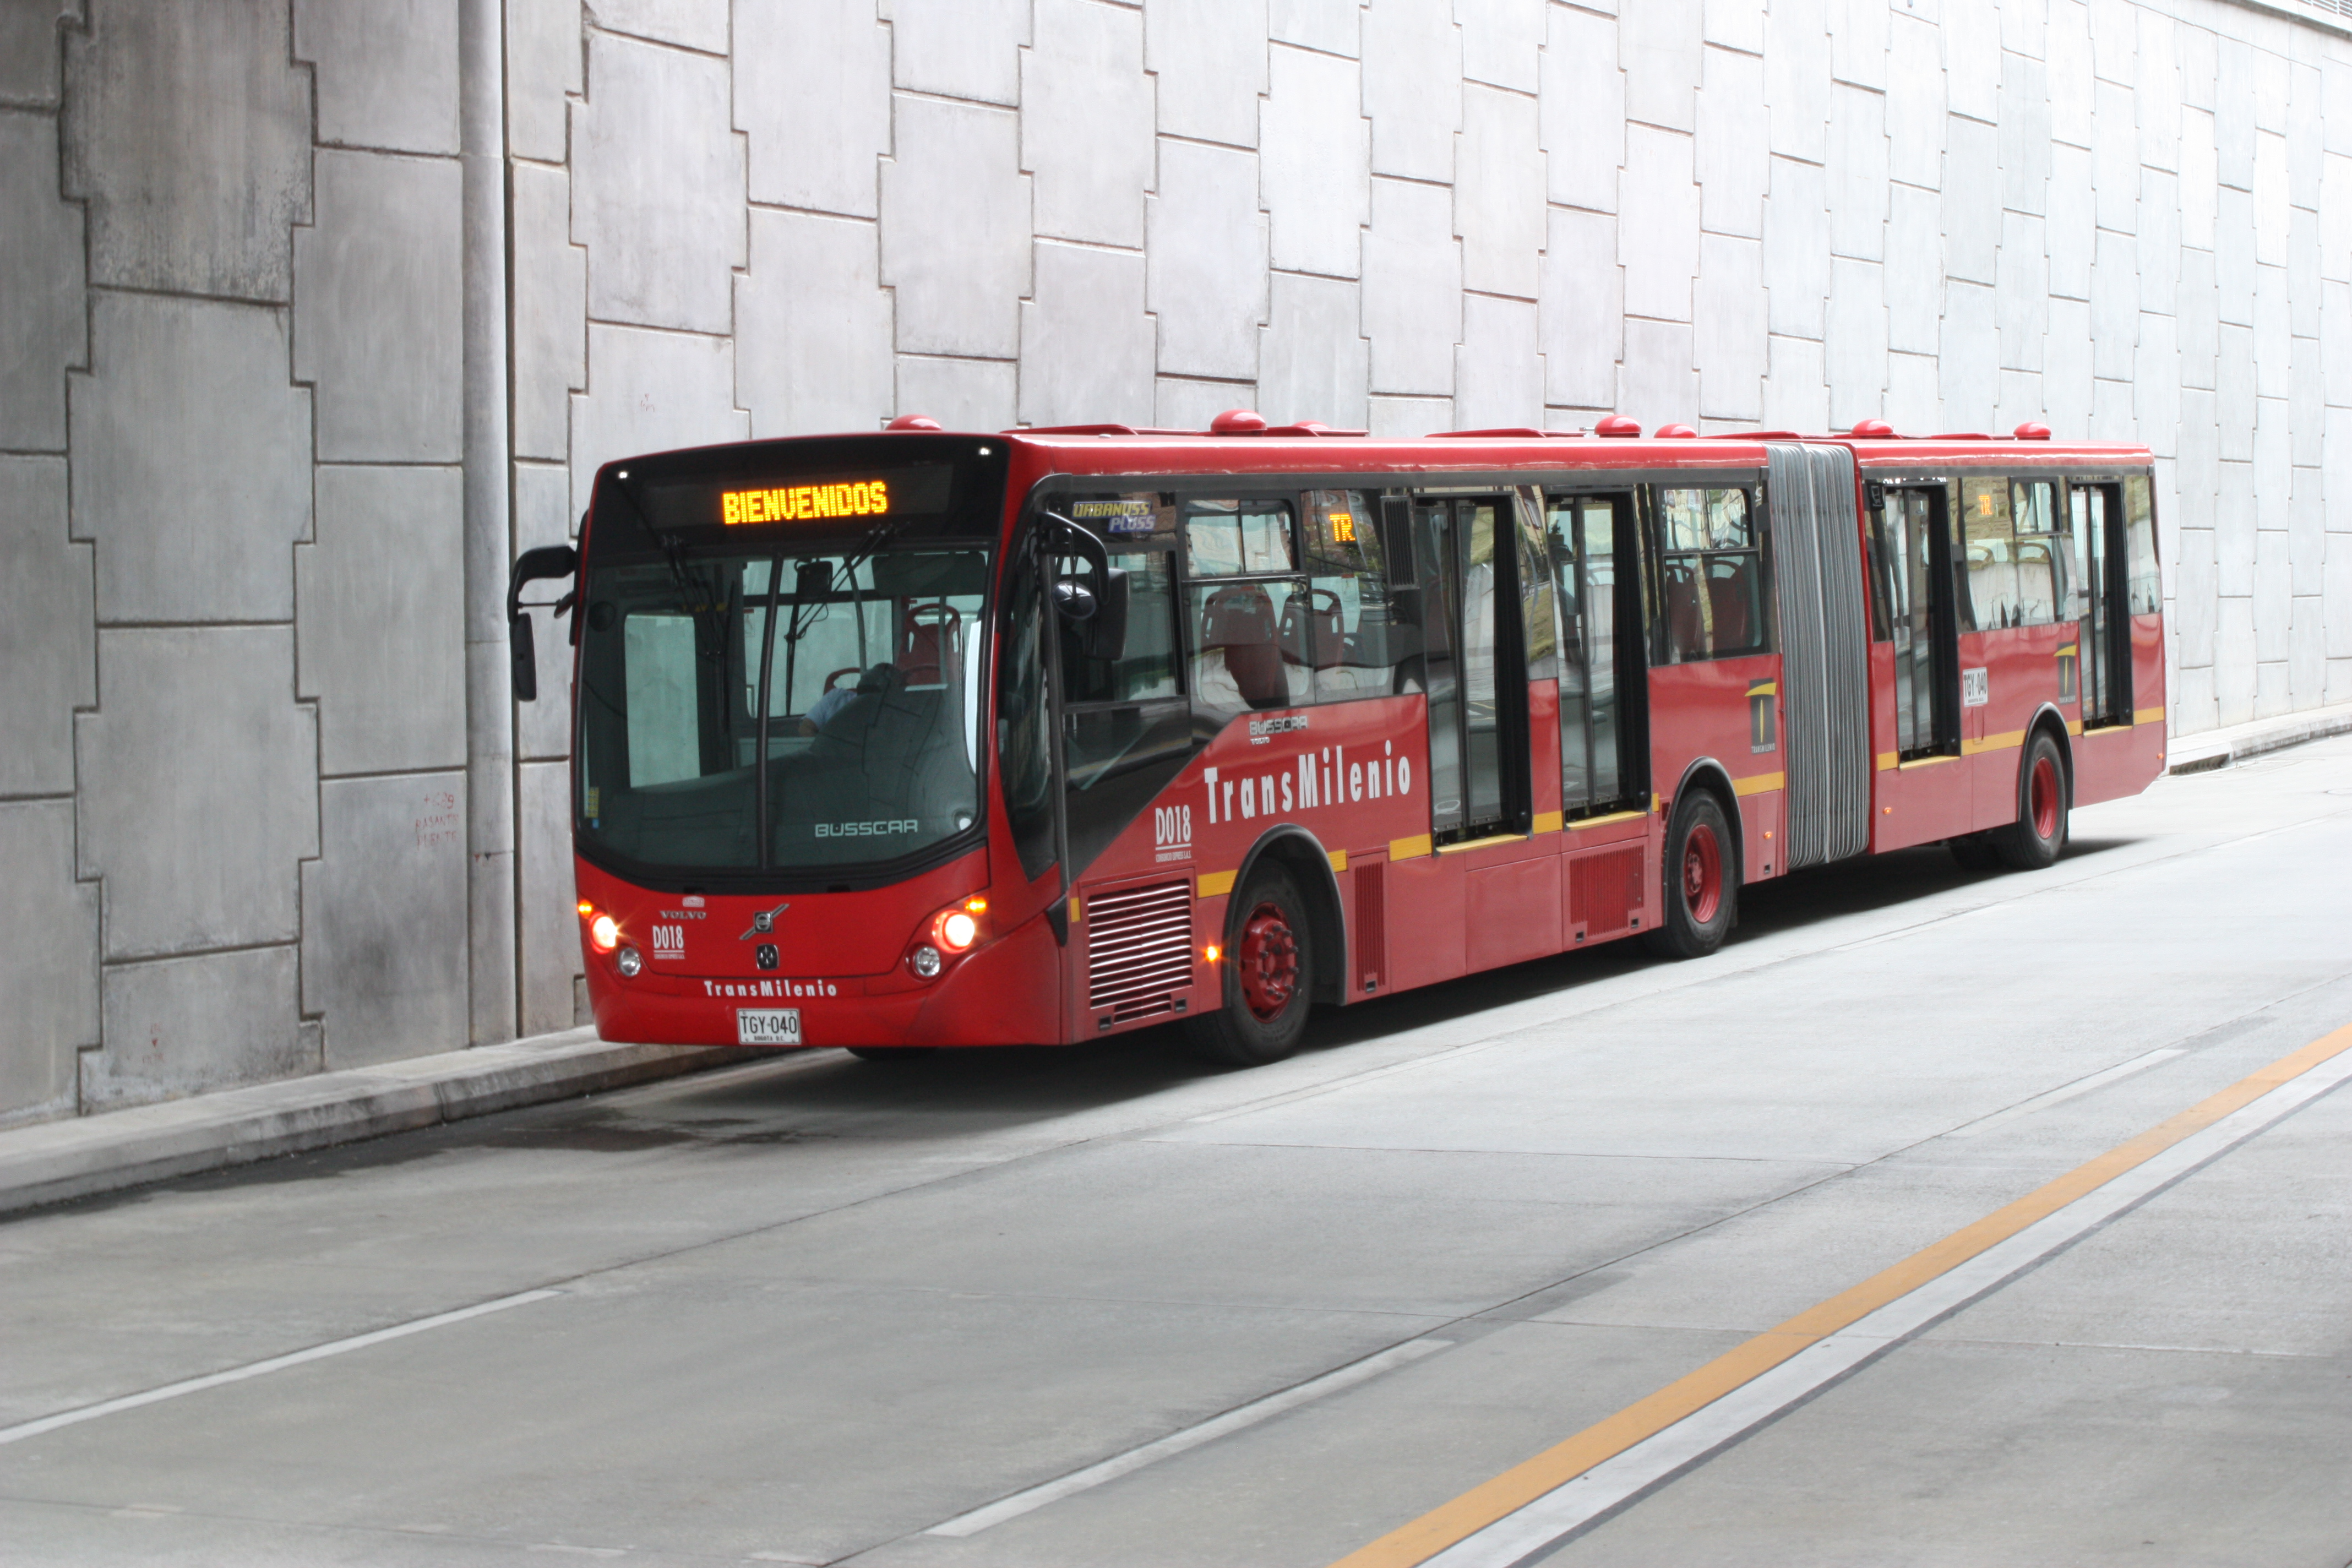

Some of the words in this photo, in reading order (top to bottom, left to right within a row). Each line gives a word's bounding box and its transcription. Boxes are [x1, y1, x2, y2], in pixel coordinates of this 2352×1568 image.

[723, 481, 887, 524] BIENVENIDOS
[1073, 503, 1150, 517] URBANUSS
[1978, 494, 1992, 516] TR
[1109, 515, 1156, 531] PLUSS
[1329, 513, 1356, 542] TR
[1249, 716, 1308, 735] BUSSCAR
[1204, 739, 1411, 824] TransMilenio
[815, 819, 918, 837] BUSSCAR
[1155, 804, 1191, 845] D018
[660, 910, 707, 920] VOLVO
[652, 925, 684, 949] D018
[704, 979, 837, 997] TransMilenio
